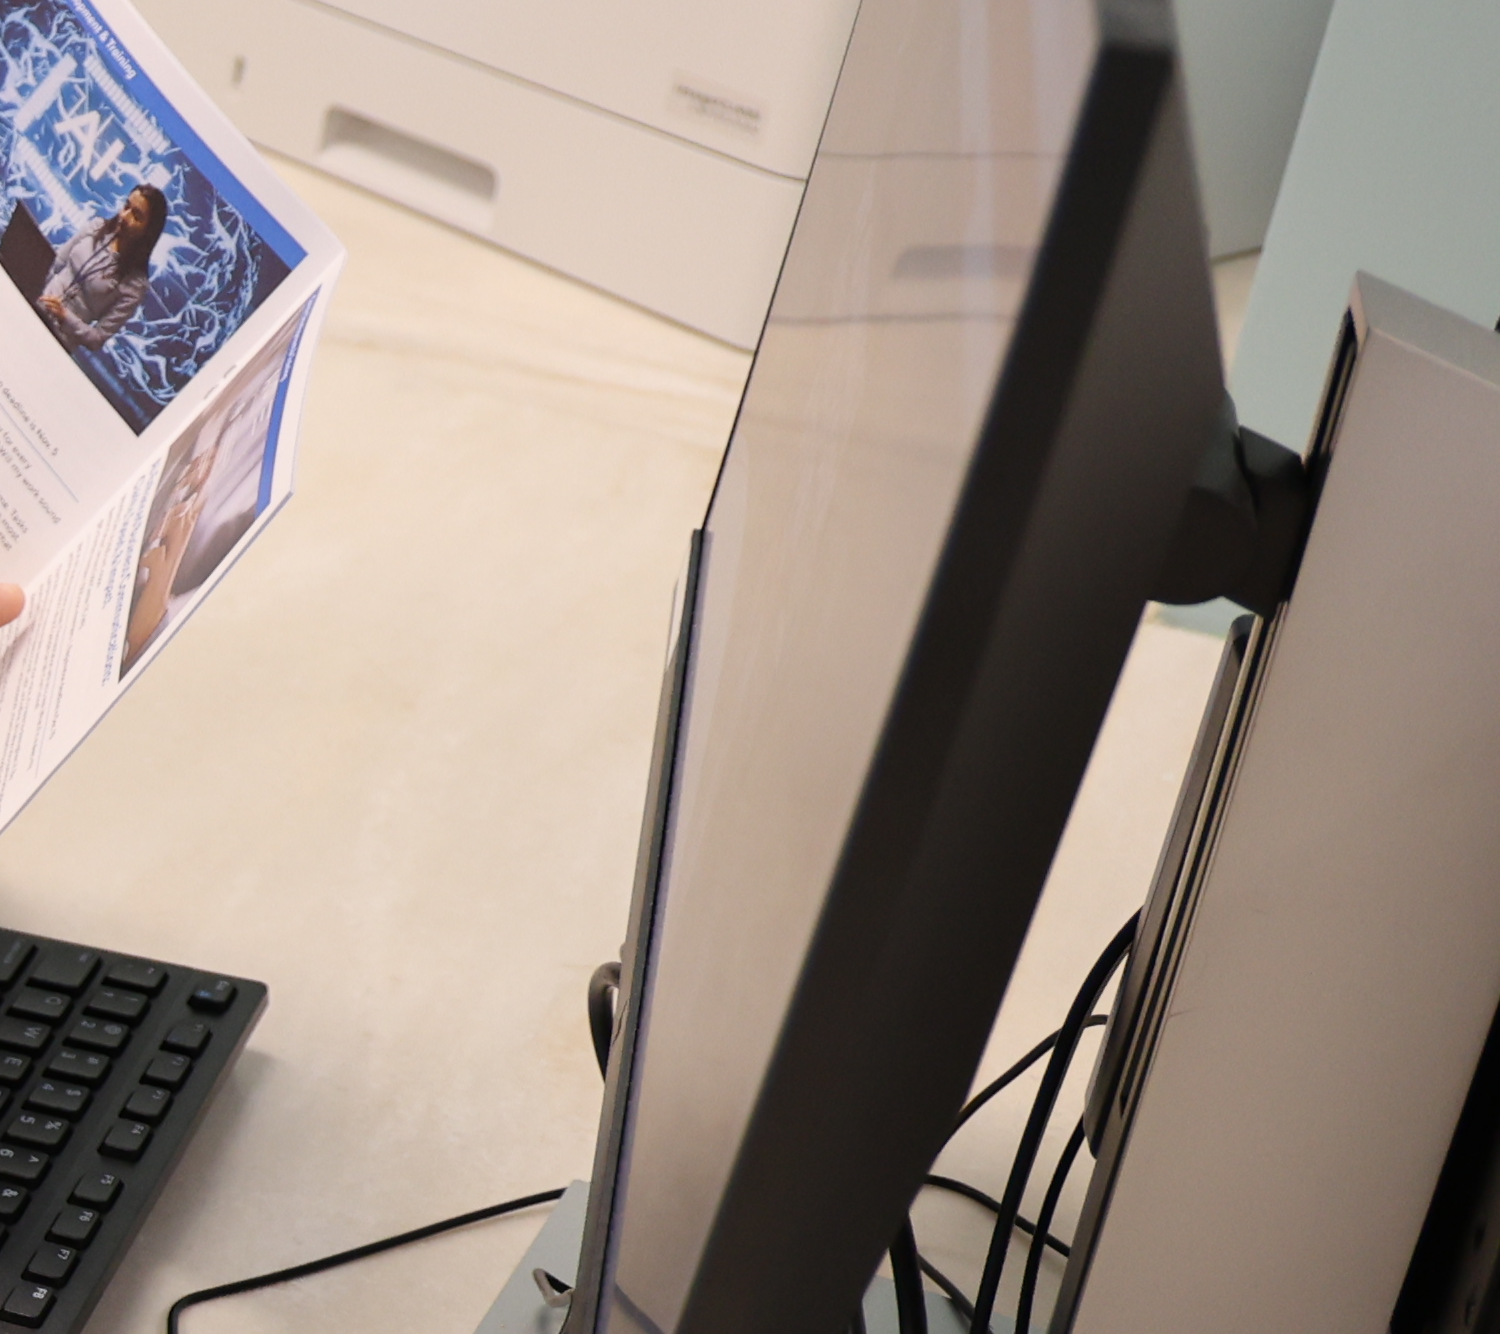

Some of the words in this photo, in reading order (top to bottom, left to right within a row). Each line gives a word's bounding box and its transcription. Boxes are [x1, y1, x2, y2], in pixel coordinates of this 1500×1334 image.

[106, 37, 136, 80] Training
[2, 387, 30, 423] deadline
[23, 1026, 41, 1039] W
[4, 1056, 23, 1066] E
